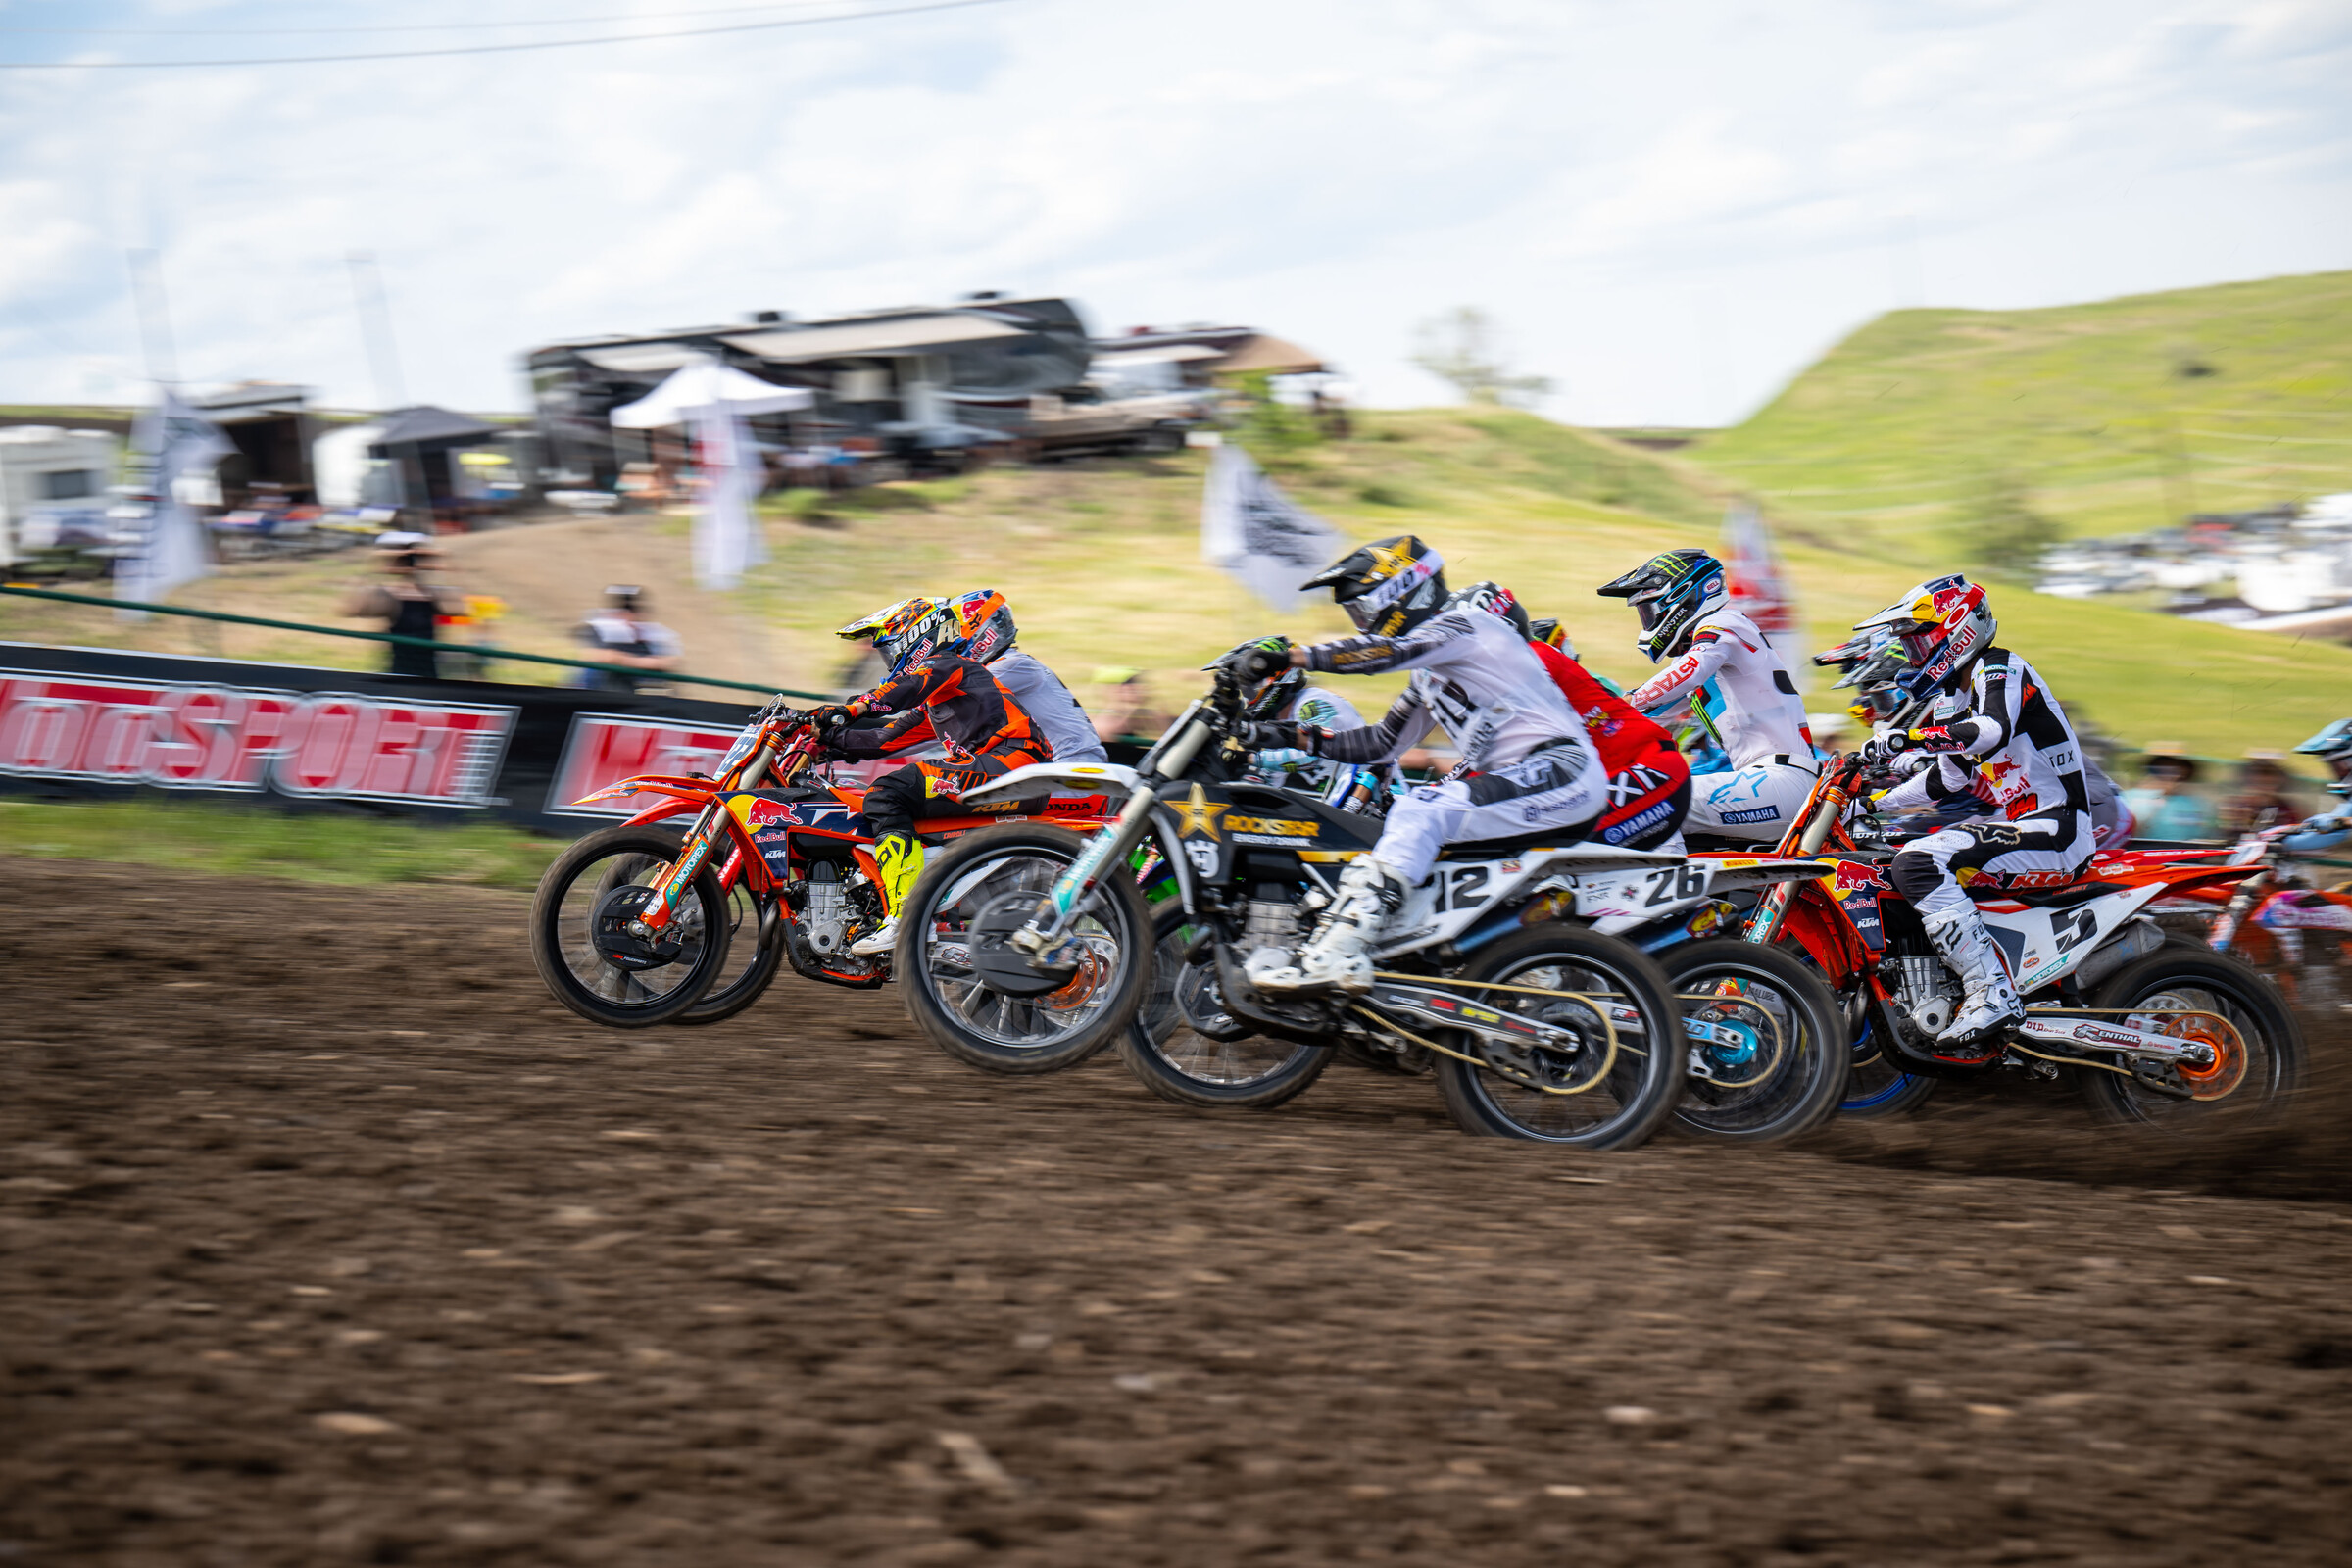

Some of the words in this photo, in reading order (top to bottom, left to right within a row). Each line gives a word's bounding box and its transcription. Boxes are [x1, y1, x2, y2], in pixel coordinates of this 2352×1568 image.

[1706, 580, 1720, 591] BELL
[901, 610, 947, 651] 100%
[1656, 607, 1688, 639] MONSTER
[975, 626, 1000, 653] Bull
[903, 655, 922, 676] Red
[914, 637, 934, 660] Bull
[1926, 648, 1956, 681] Red
[1951, 624, 1978, 660] Bull
[972, 800, 1020, 813] KTM
[1045, 802, 1092, 812] ONDA
[1618, 800, 1675, 836] YAMAHA
[1736, 808, 1778, 823] YAMAHA
[755, 832, 771, 843] Red
[770, 831, 786, 842] Bull
[1224, 814, 1321, 837] ROCKSTAR
[677, 840, 708, 886] MOTOREX
[717, 848, 740, 882] NLOP
[764, 849, 786, 859] KTM
[1435, 866, 1491, 914] 12
[1645, 862, 1706, 908] 26
[2008, 869, 2075, 890] KTM
[1843, 900, 1861, 910] Red
[1861, 896, 1878, 908] Bull
[1751, 918, 1771, 944] OREX
[1857, 916, 1880, 929] KTM
[2049, 901, 2099, 955] 5
[2032, 958, 2064, 981] MOTOREX
[1959, 1029, 1976, 1043] FOX
